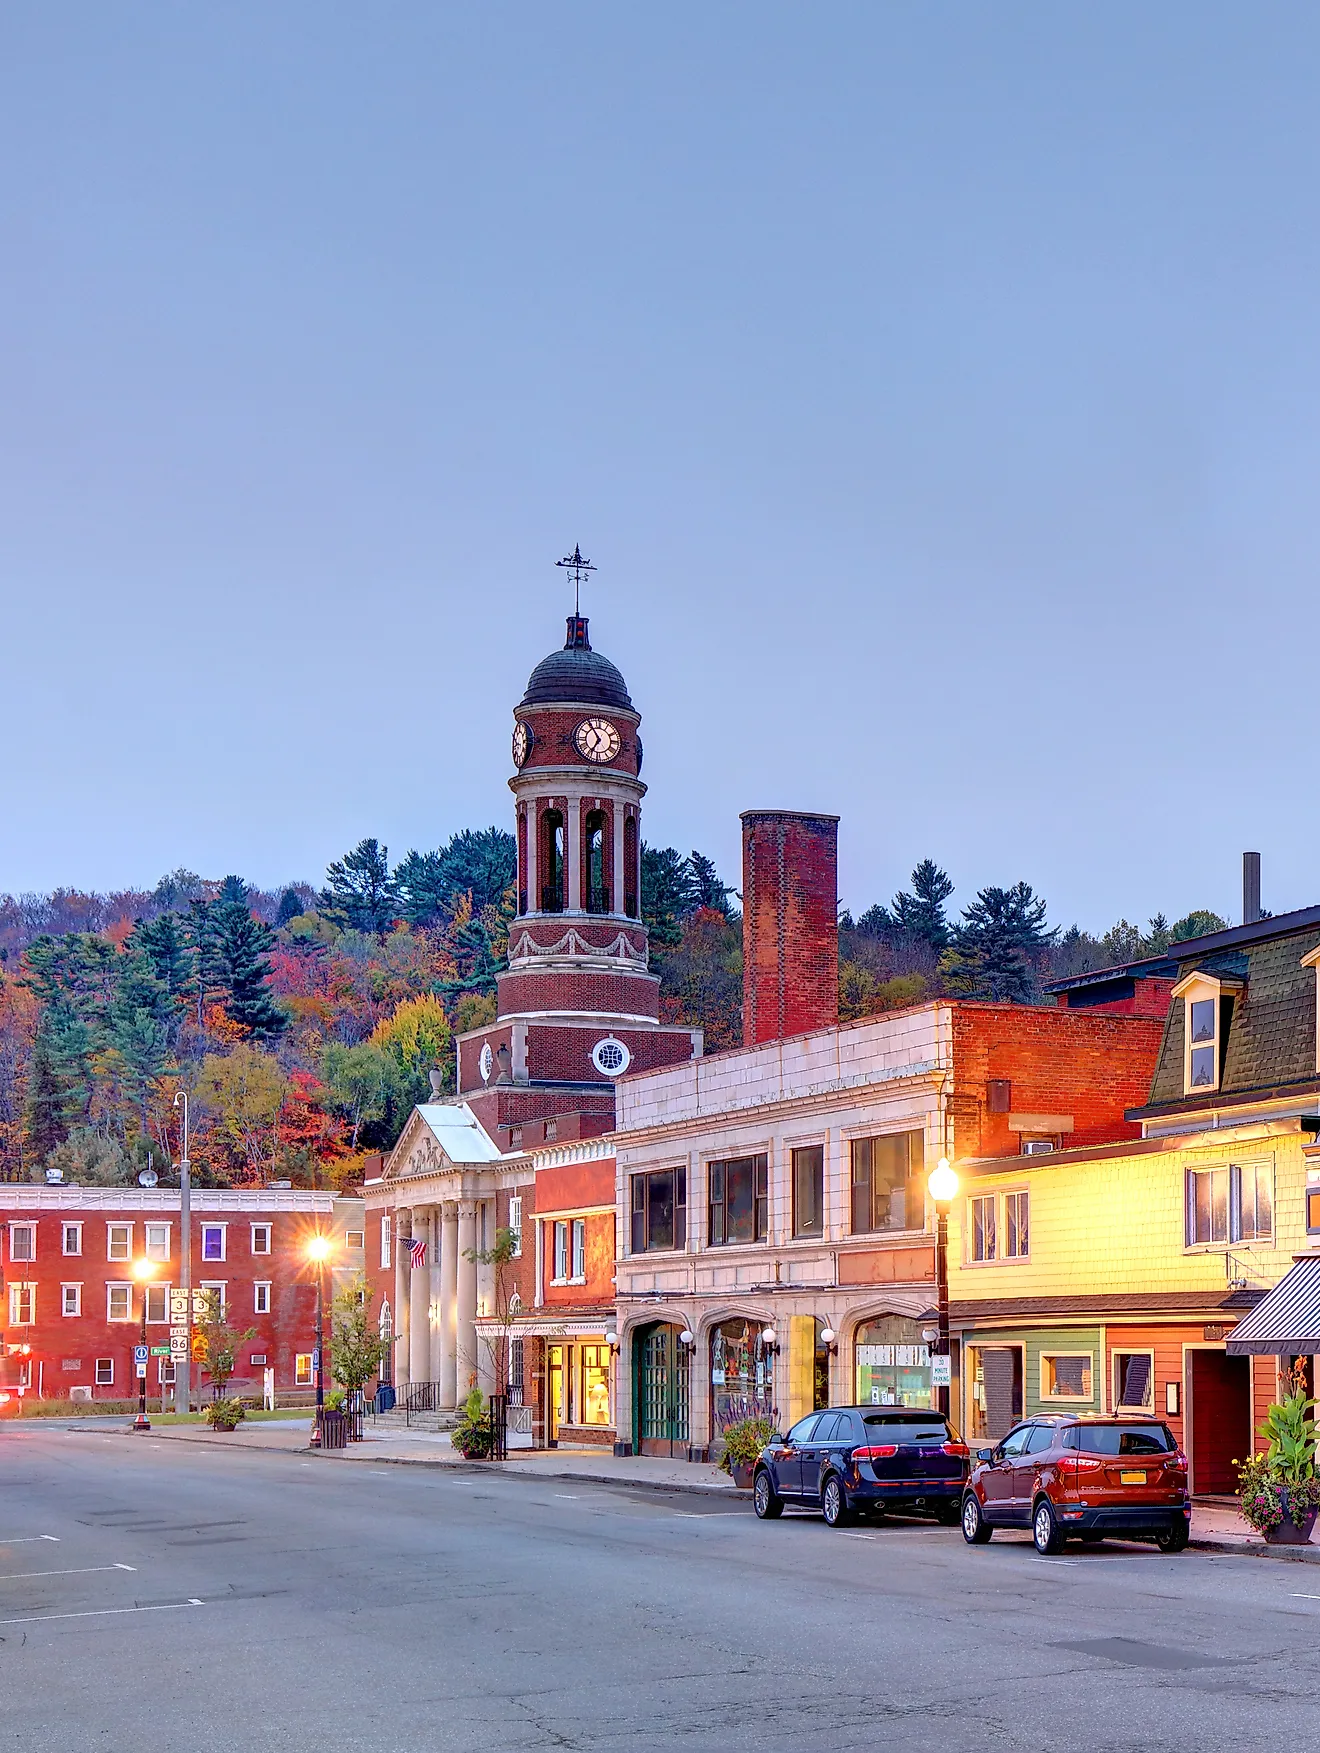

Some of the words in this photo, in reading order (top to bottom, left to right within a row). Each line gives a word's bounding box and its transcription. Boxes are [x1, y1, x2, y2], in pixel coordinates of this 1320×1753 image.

[176, 1300, 183, 1310] 3
[198, 1300, 205, 1310] 3
[171, 1339, 186, 1349] 86
